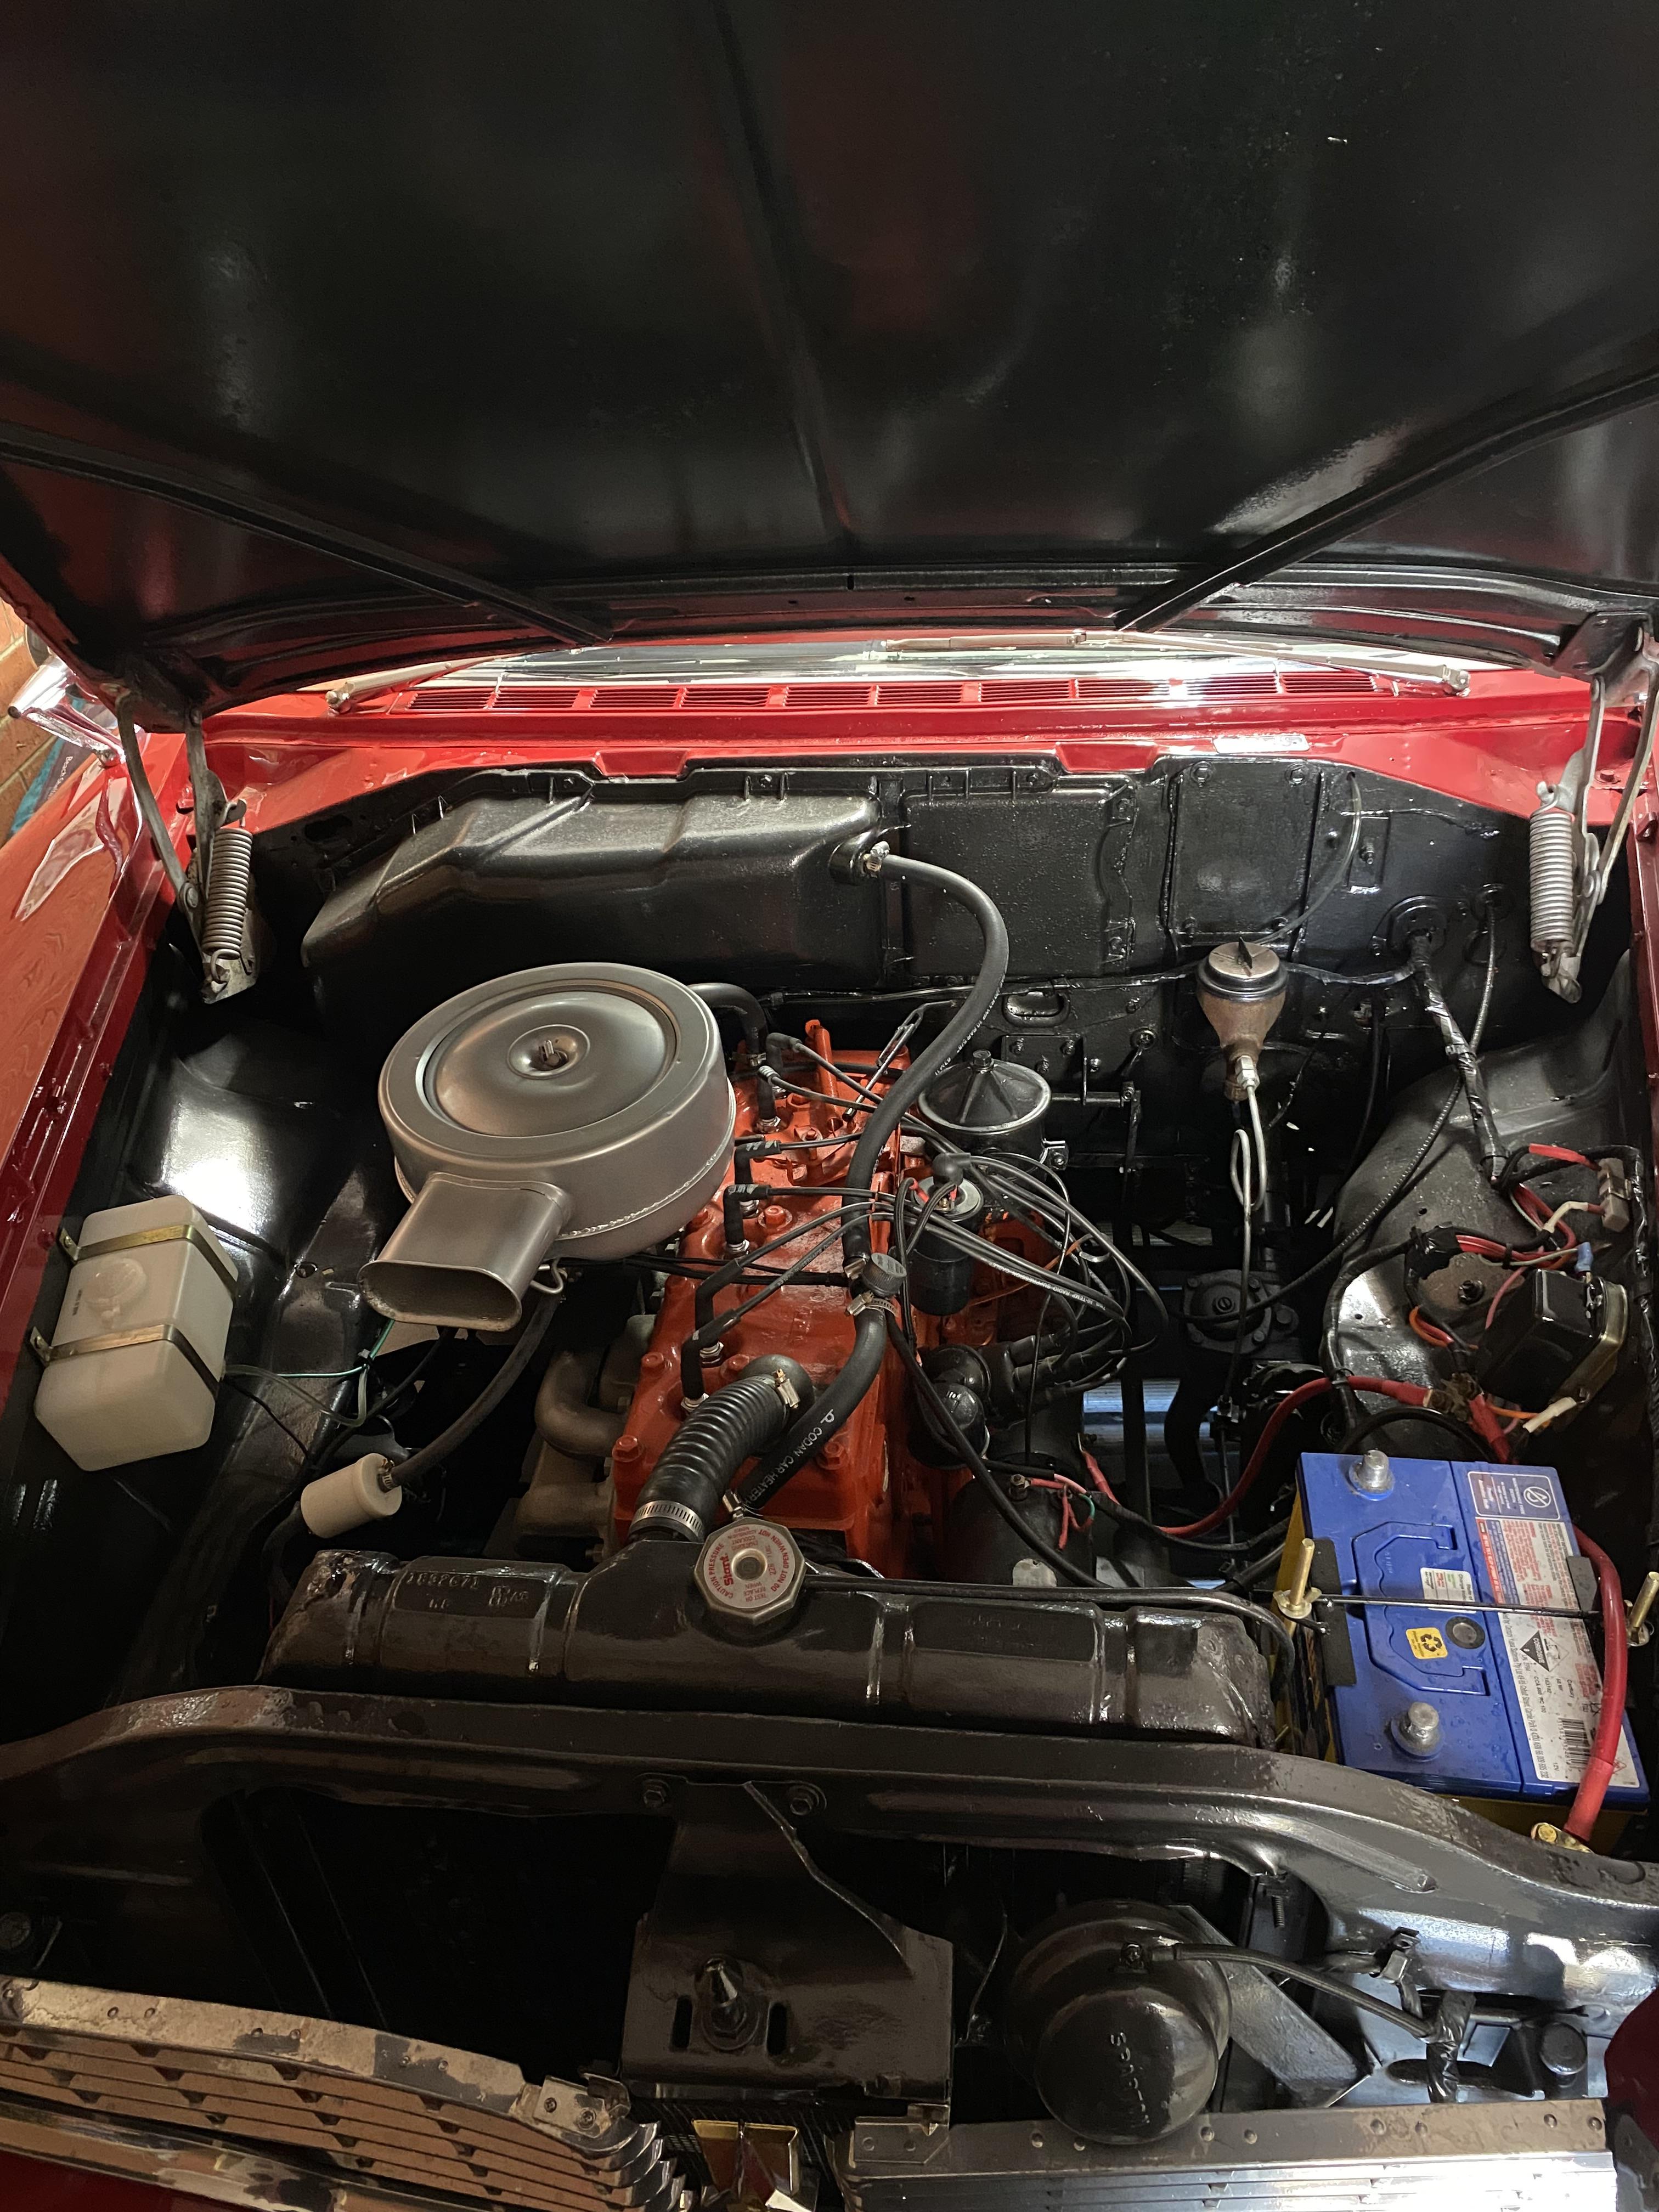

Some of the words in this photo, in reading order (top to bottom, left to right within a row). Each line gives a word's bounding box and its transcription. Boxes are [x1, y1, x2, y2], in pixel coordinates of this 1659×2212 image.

[1011, 1269, 1052, 1290] SUPPRESSION
[1052, 1284, 1070, 1297] RADIO
[1071, 1291, 1093, 1305] HI-TEMP
[794, 1426, 823, 1457] CODAN
[775, 1455, 795, 1475] CAR
[748, 1470, 778, 1503] HEATER
[732, 1535, 756, 1545] COOLANT
[758, 1529, 771, 1537] HOT
[770, 1535, 786, 1553] WHEN
[708, 1543, 725, 1576] PRESSURE
[777, 1570, 788, 1584] NOT
[709, 1576, 734, 1599] CAUTION
[743, 1587, 766, 1596] REPLACE
[770, 1583, 780, 1592] DO
[1532, 1638, 1545, 1663] CORROSIVE
[1566, 1679, 1575, 1699] Century
[1539, 1770, 1549, 1779] 232
